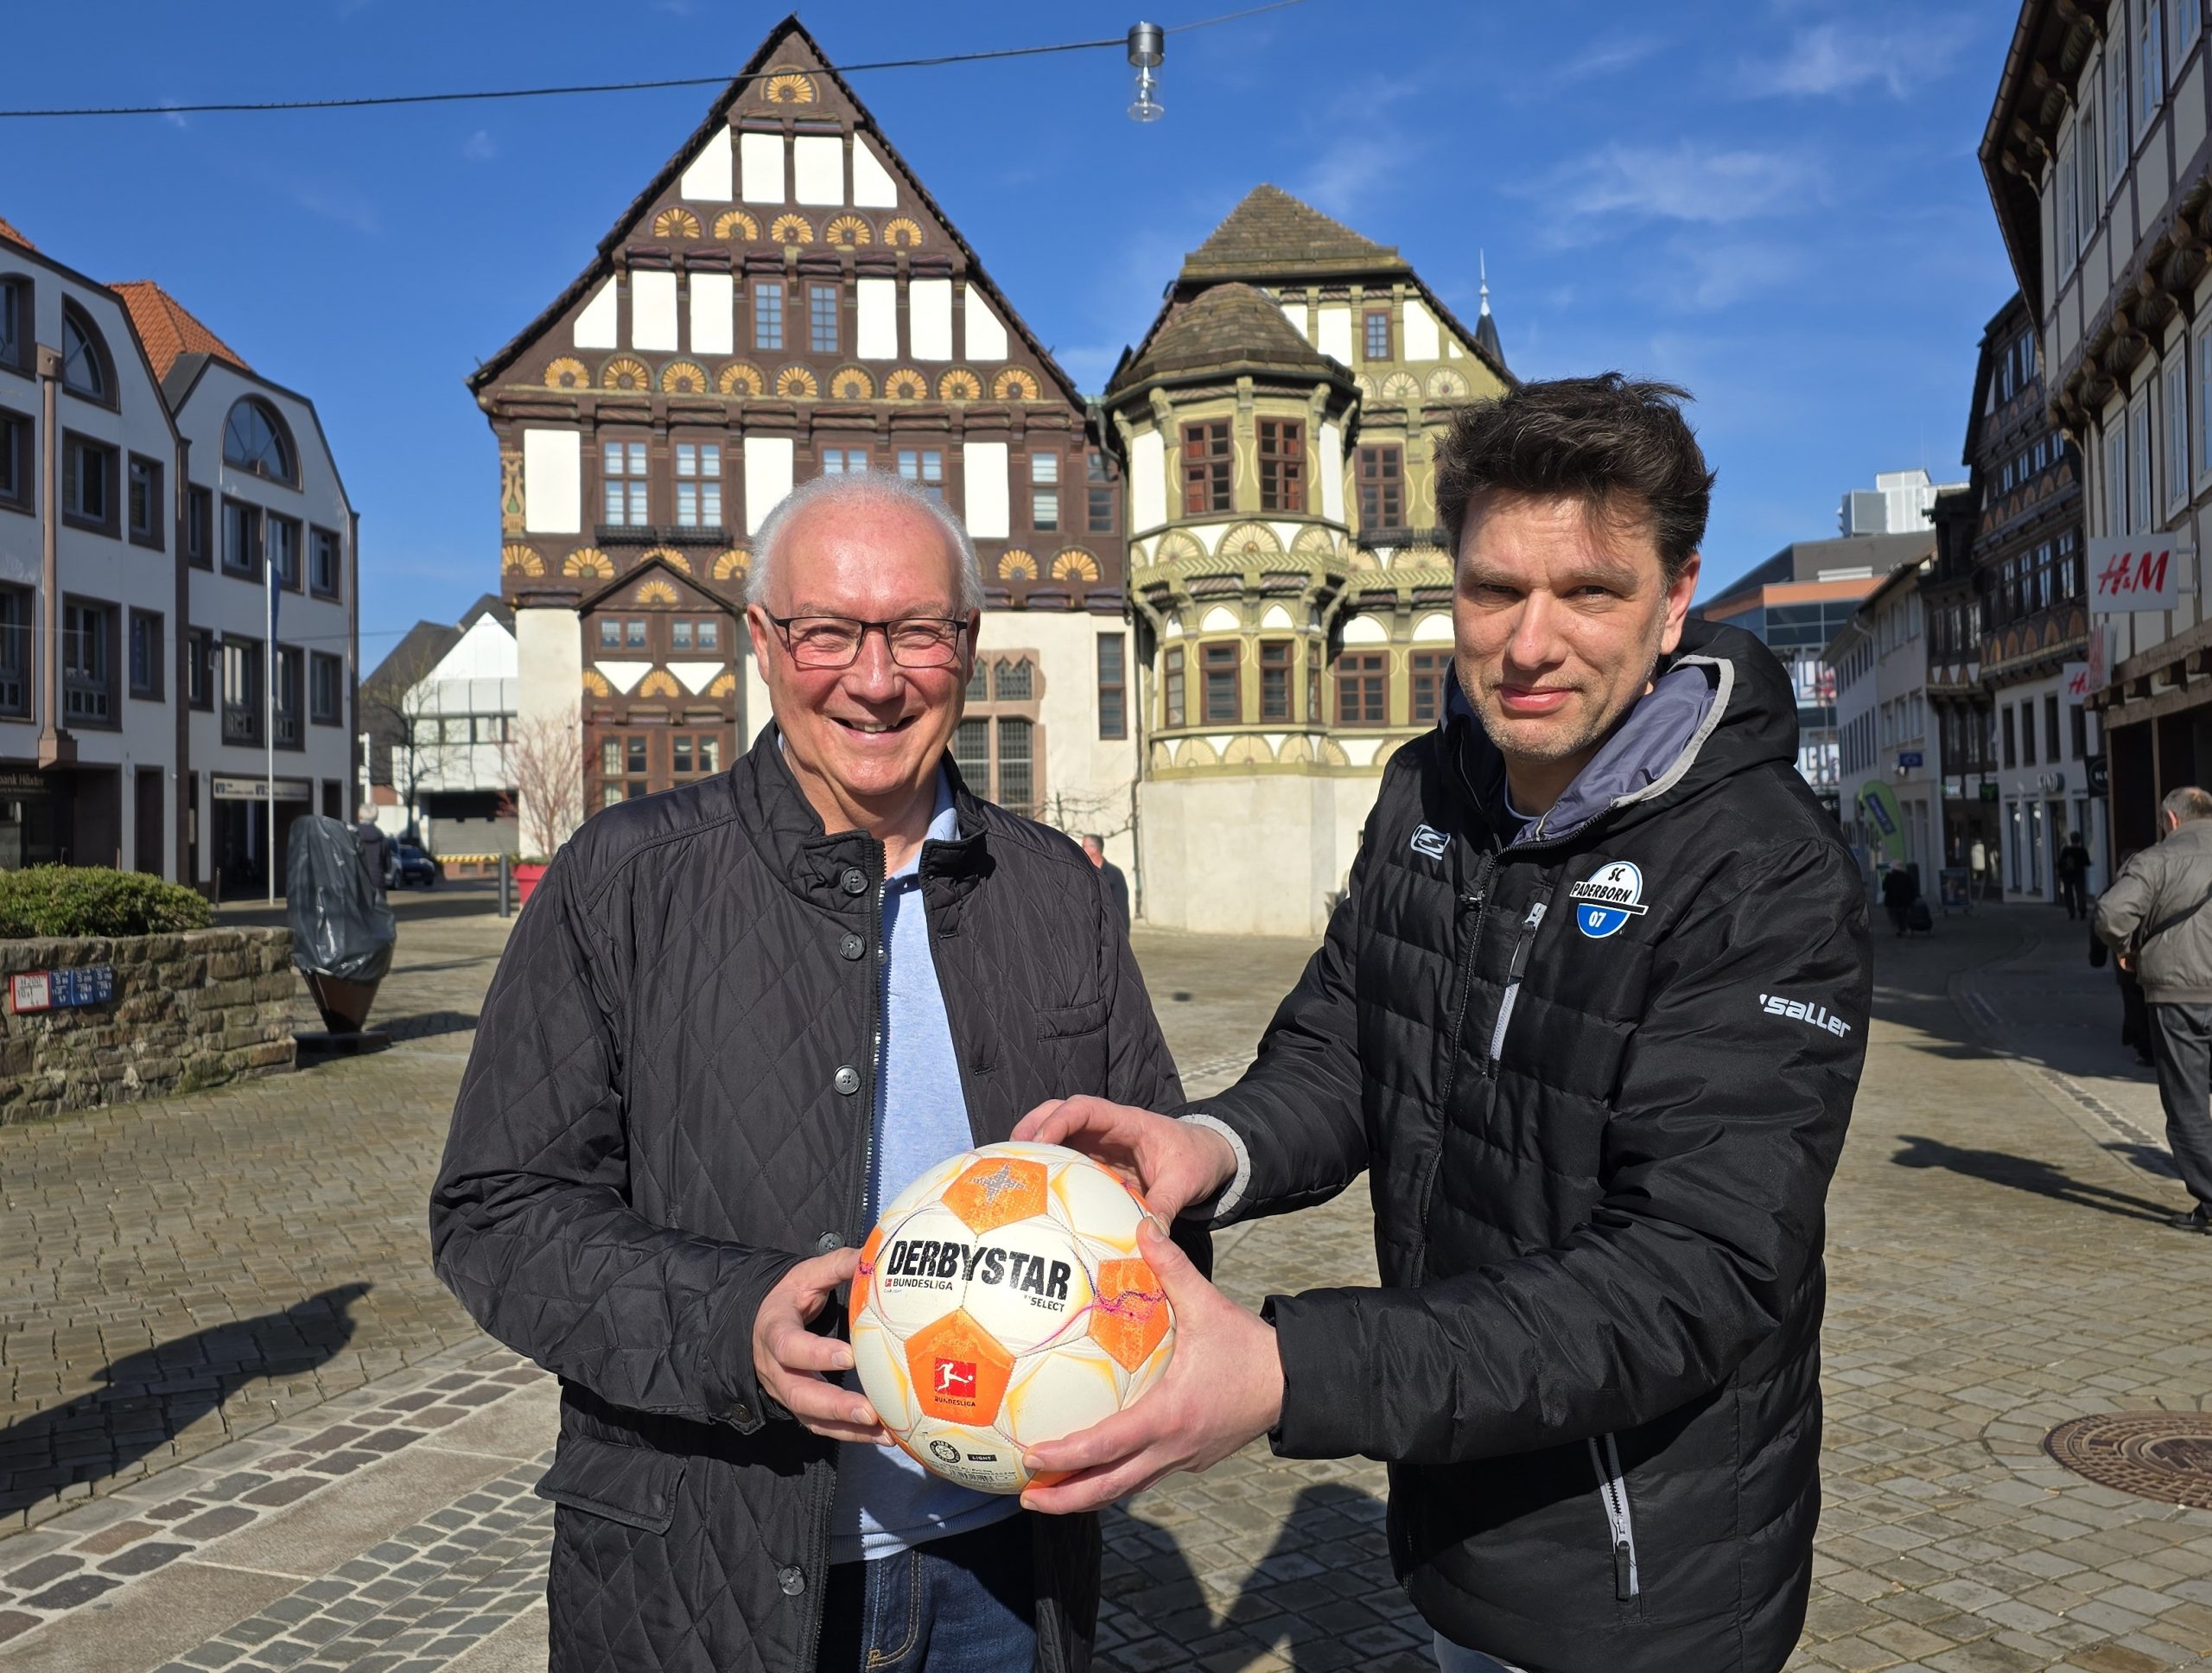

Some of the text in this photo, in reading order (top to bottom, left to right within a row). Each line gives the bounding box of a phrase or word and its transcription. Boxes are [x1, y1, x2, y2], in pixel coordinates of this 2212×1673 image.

[2097, 550, 2170, 596] H&M
[1608, 868, 1625, 881] SC
[1572, 883, 1632, 902] PADERBORN
[1588, 911, 1607, 928] 07
[887, 1240, 1071, 1301] DERBYSTAR
[893, 1278, 953, 1291] BUNDESLIGA
[1030, 1297, 1065, 1313] SELECT
[934, 1396, 976, 1407] BUNDESLIGA
